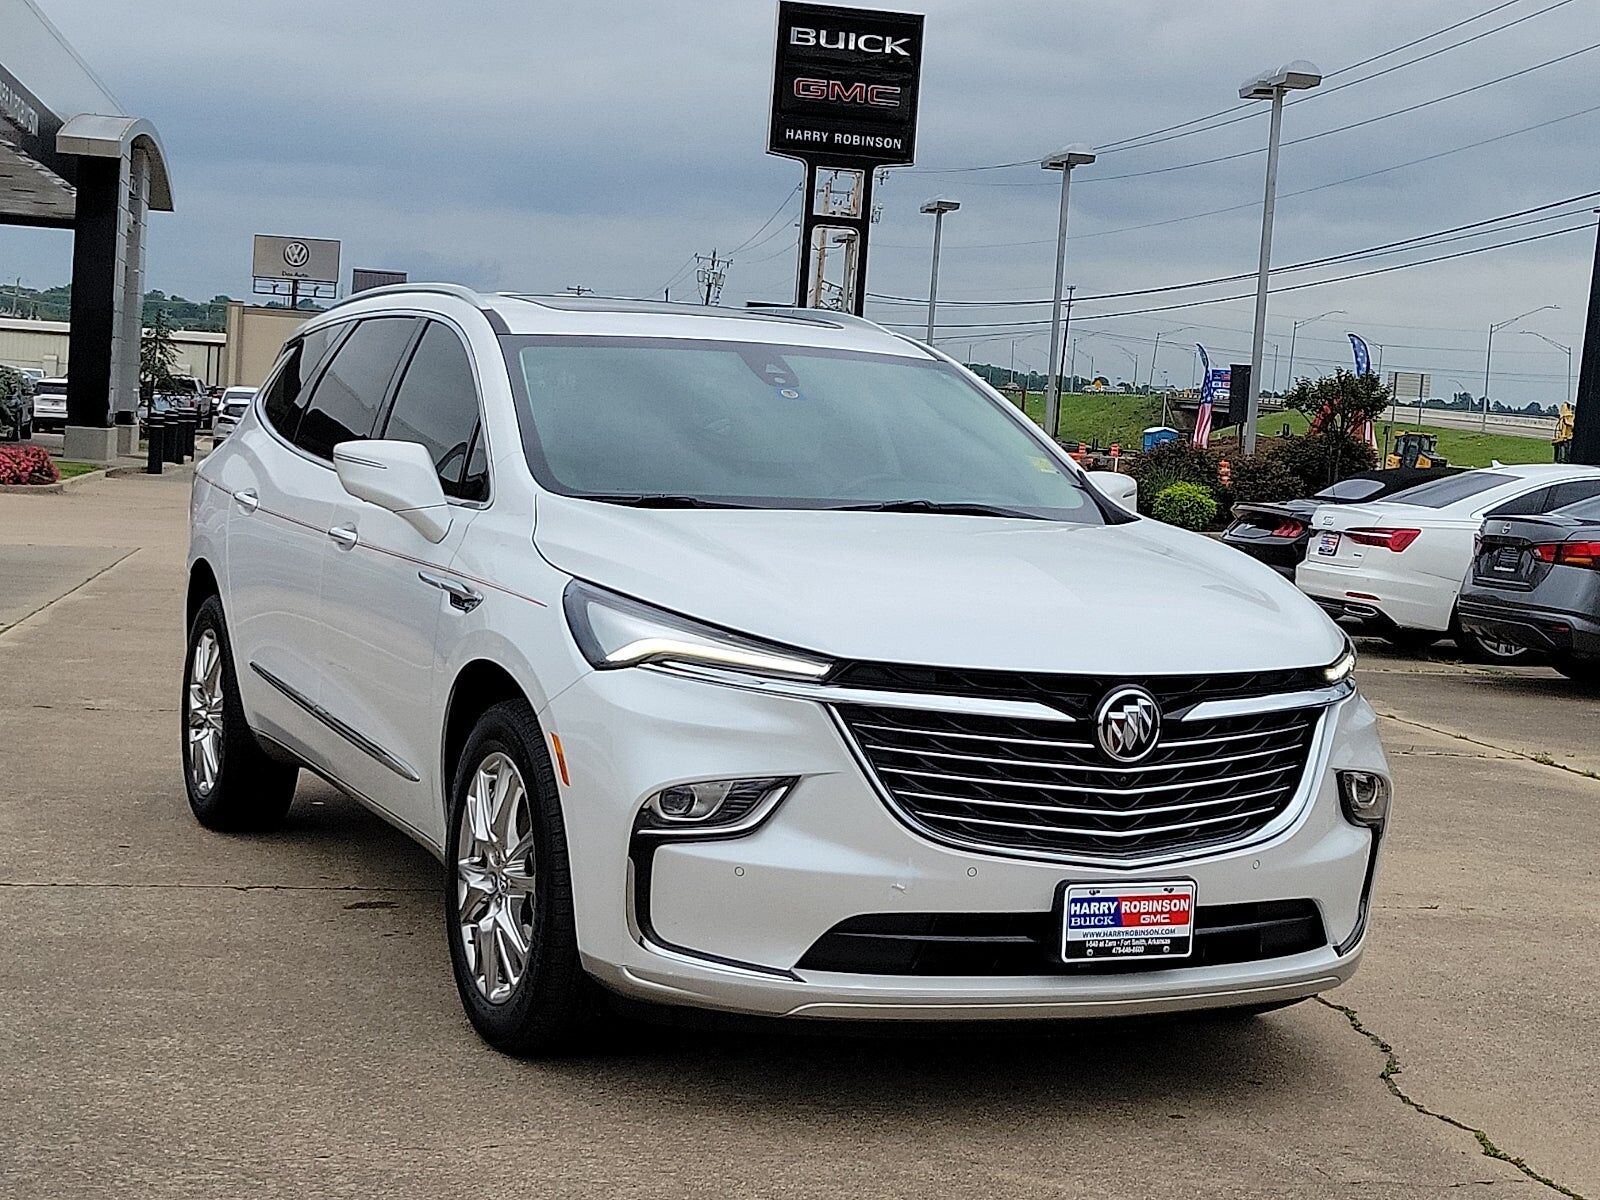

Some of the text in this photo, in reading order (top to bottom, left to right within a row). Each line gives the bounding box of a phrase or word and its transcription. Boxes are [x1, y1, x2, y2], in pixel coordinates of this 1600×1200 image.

[789, 26, 911, 56] BUICK
[793, 77, 901, 107] GMC
[785, 128, 902, 150] HARRY ROBINSON
[1070, 898, 1190, 916] HARRY ROBINSON
[1070, 915, 1115, 927] BUICK
[1140, 914, 1171, 924] GMC
[1082, 928, 1176, 939] WWW.HARRYROBINSON.COM
[1120, 939, 1131, 947] Fort
